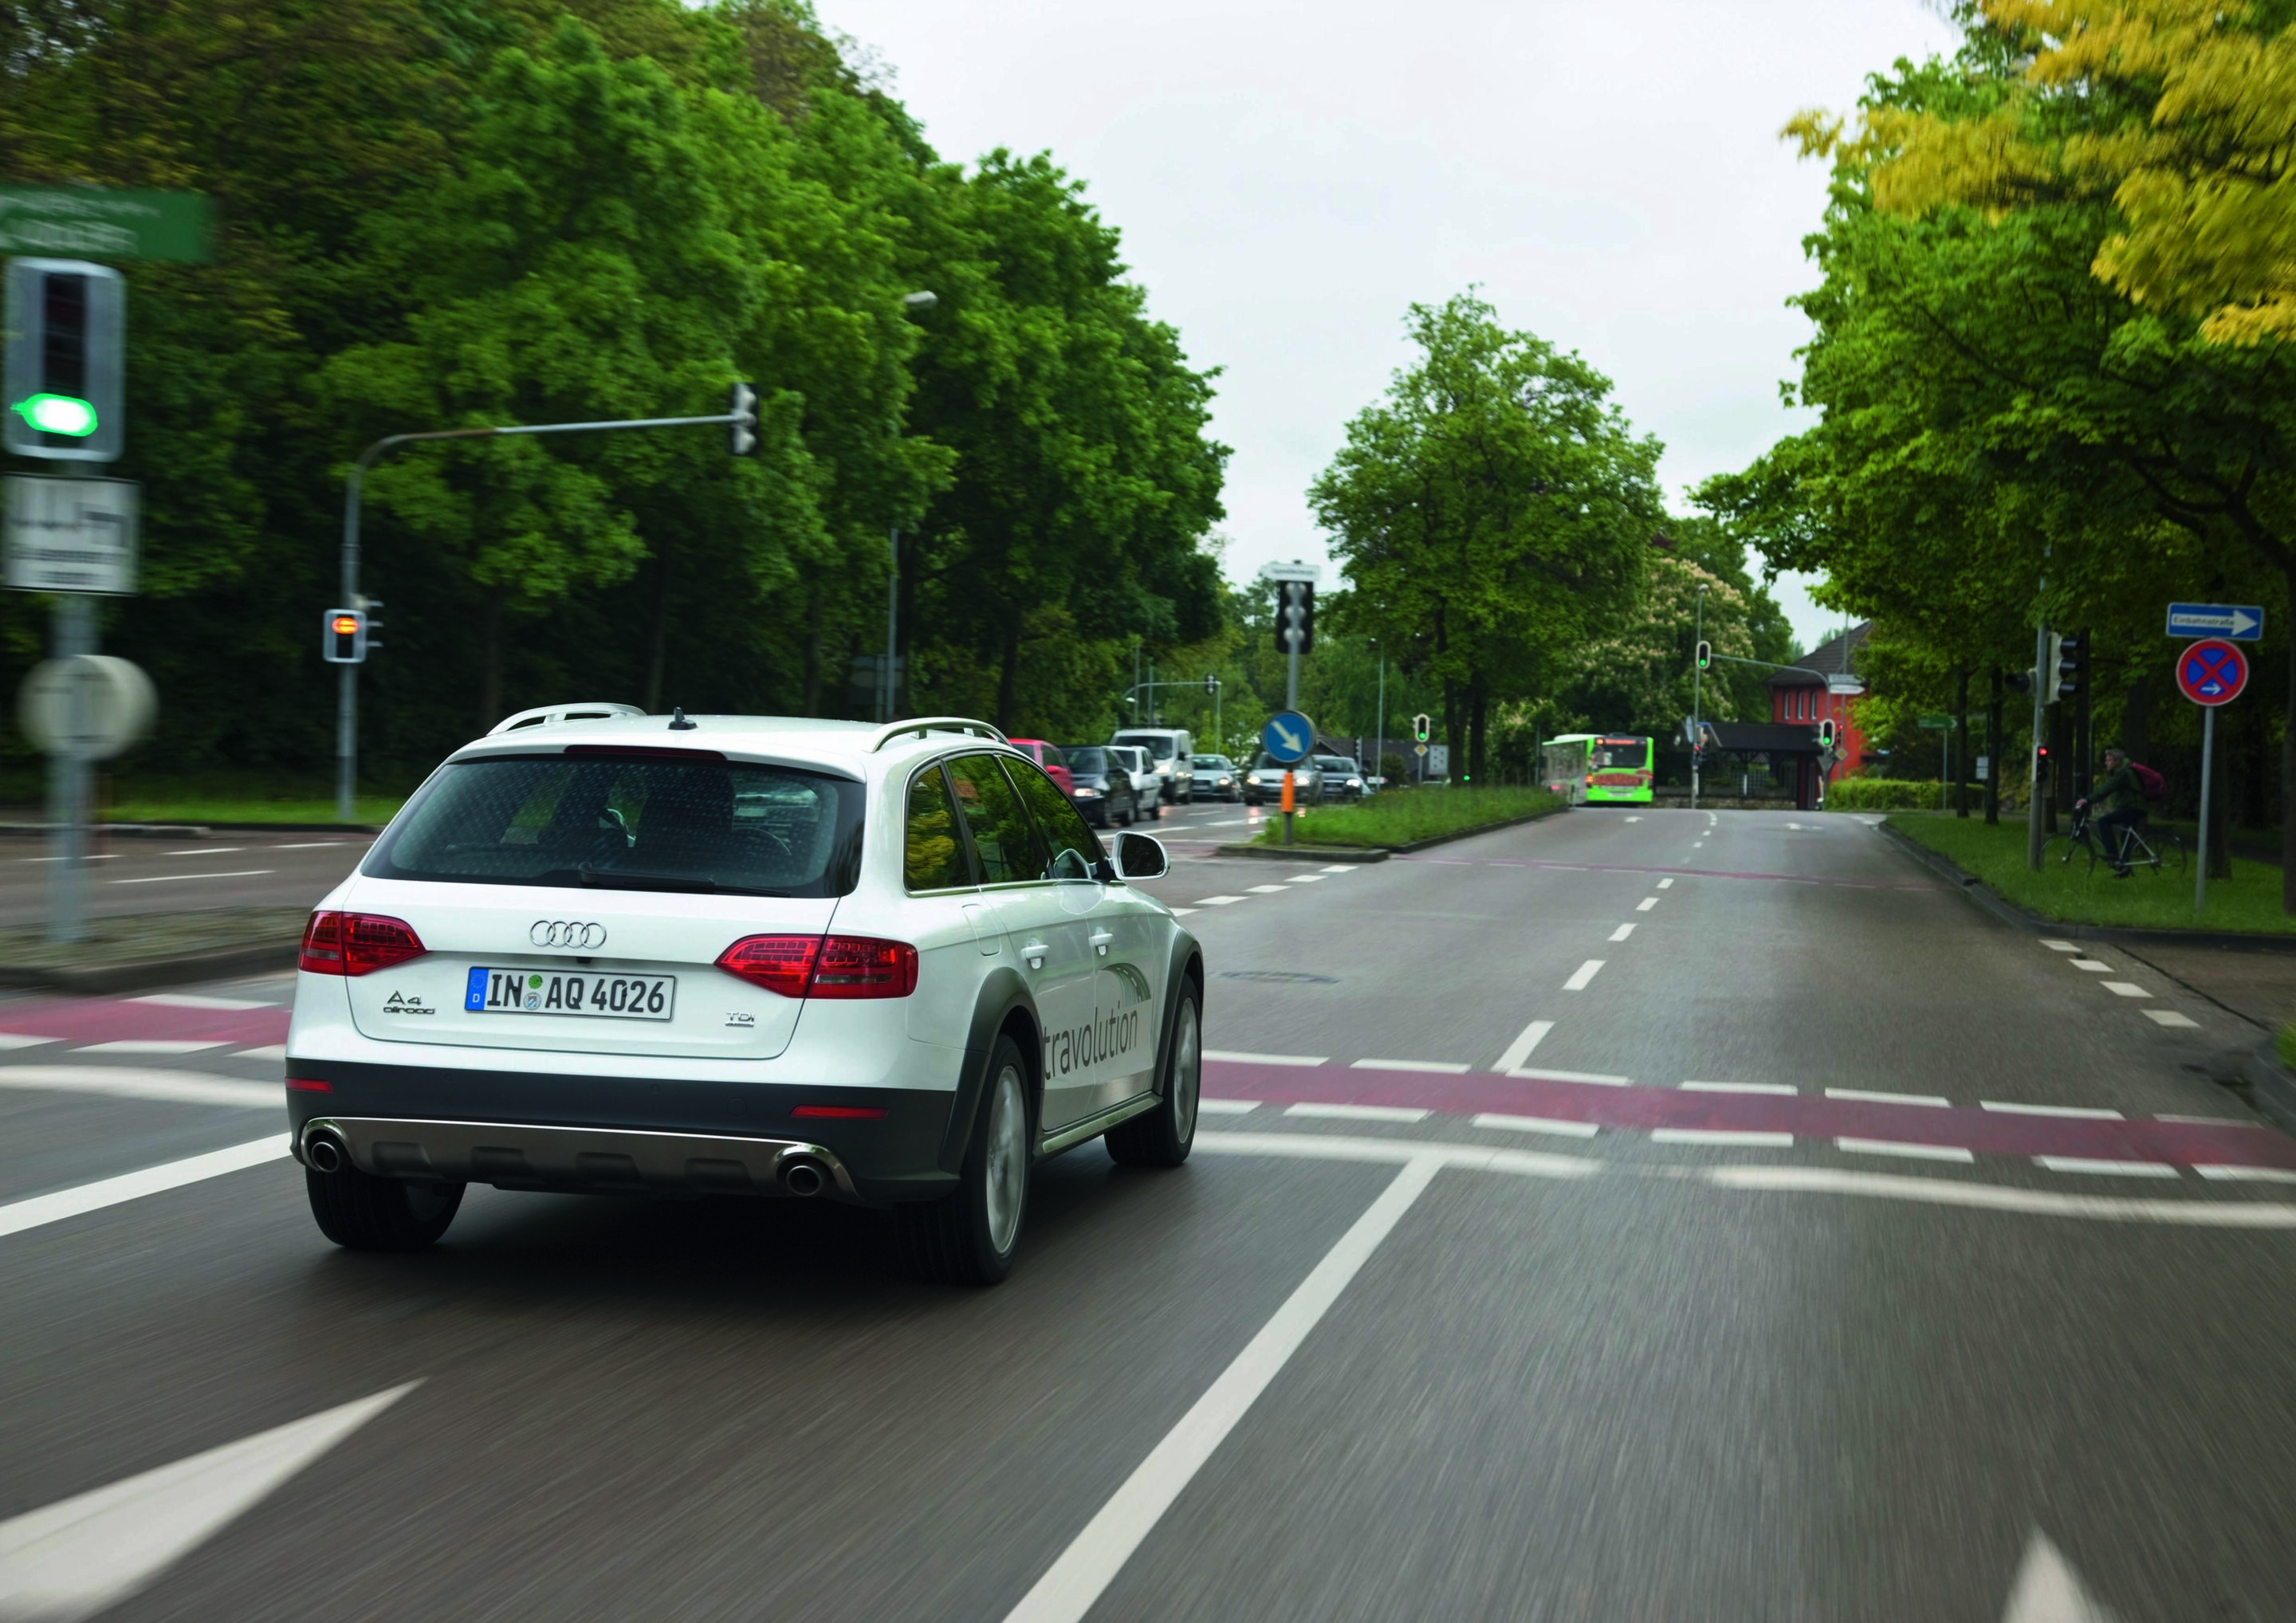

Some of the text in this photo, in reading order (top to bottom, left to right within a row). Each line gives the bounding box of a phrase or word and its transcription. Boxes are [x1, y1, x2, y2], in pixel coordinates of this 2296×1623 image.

[387, 990, 422, 1005] A4
[472, 993, 480, 1003] D
[487, 974, 664, 1013] IN AQ 4026
[383, 1006, 435, 1015] allroad
[1044, 1000, 1138, 1080] travolution
